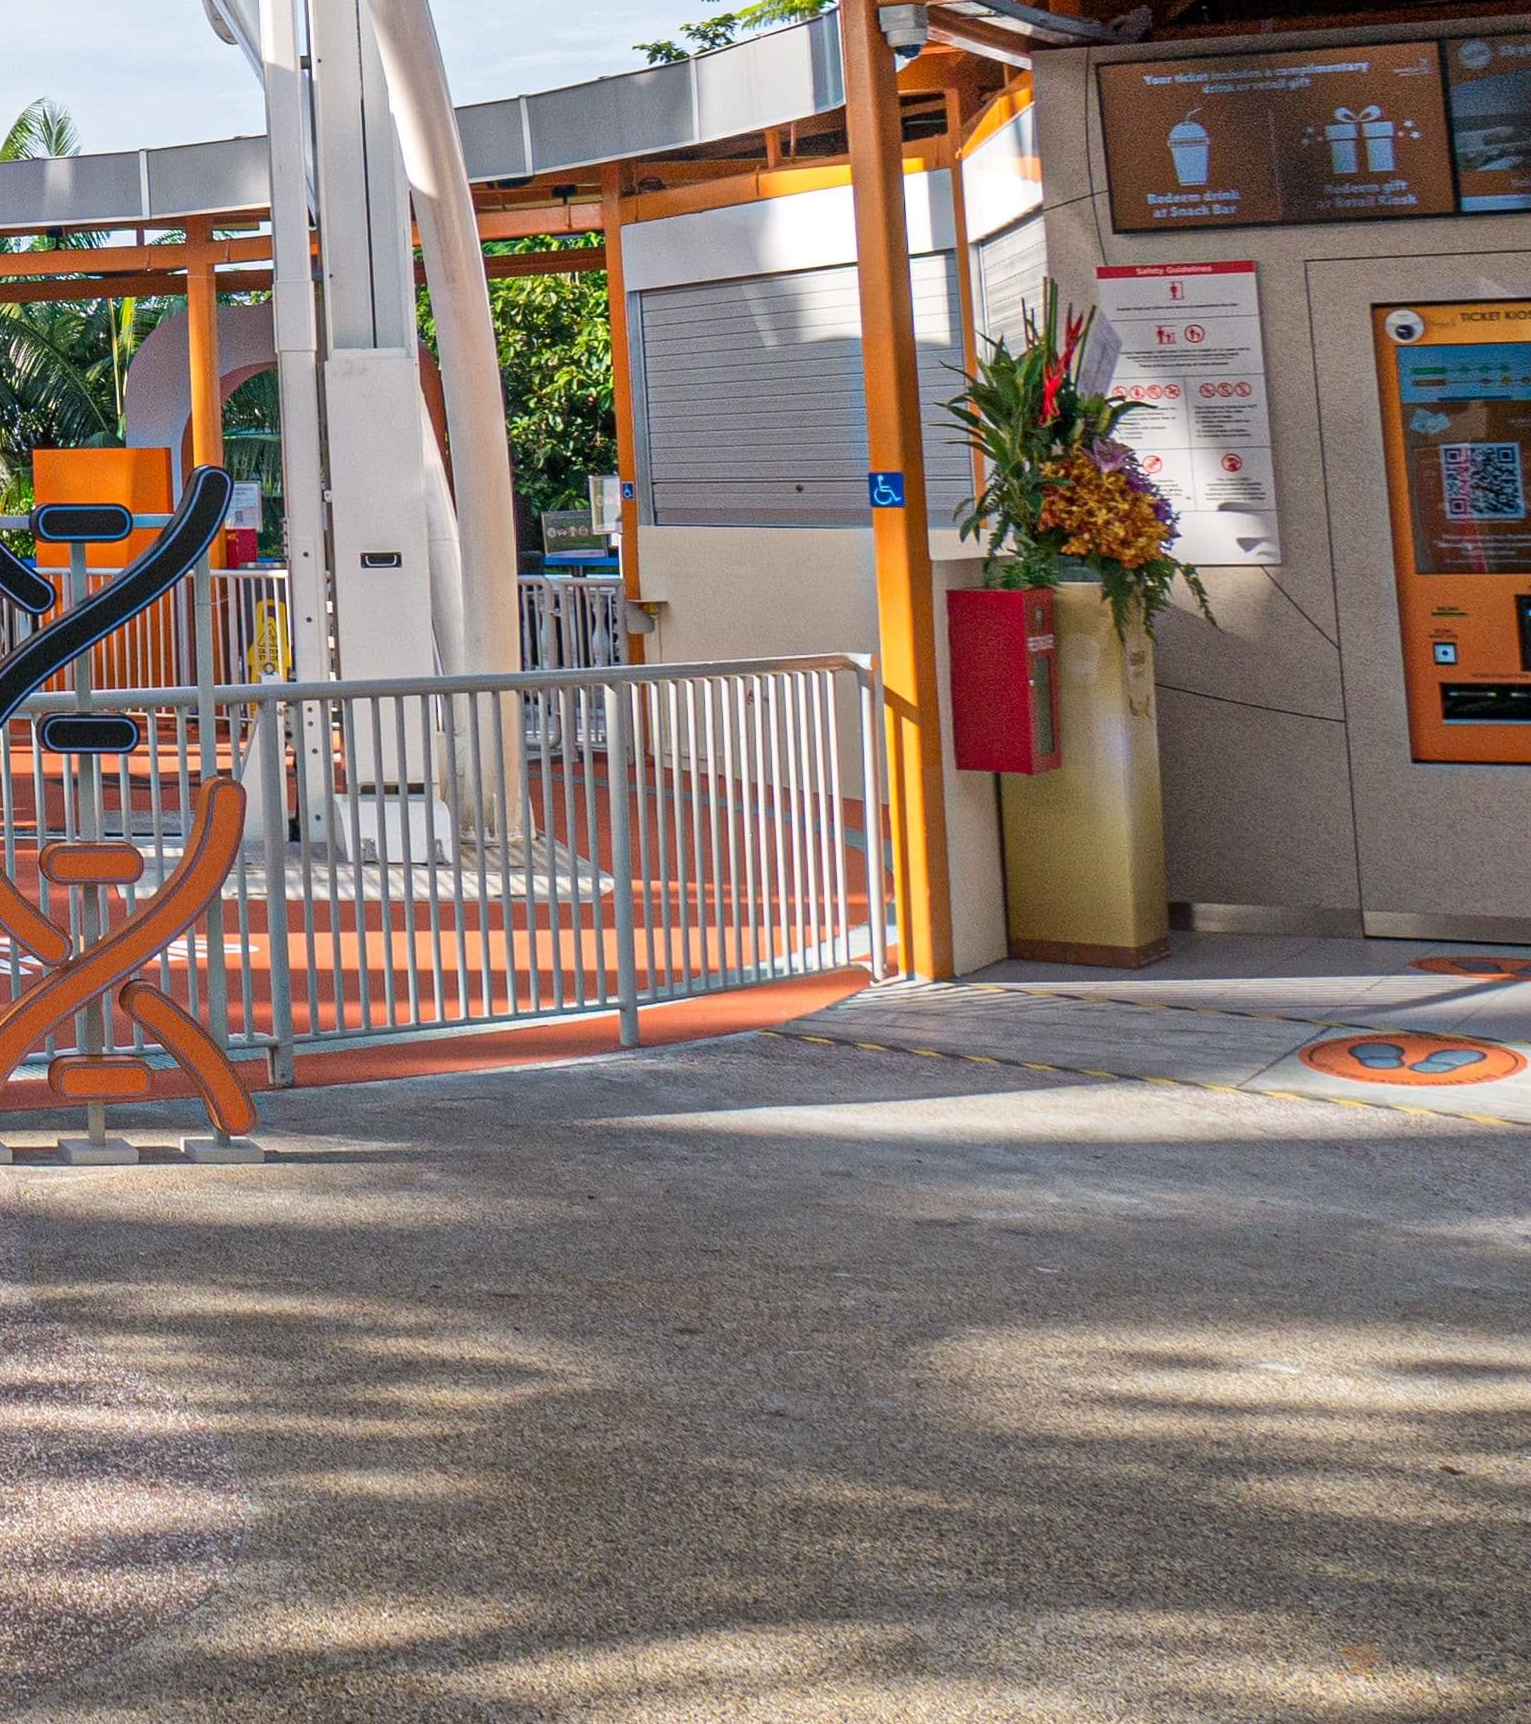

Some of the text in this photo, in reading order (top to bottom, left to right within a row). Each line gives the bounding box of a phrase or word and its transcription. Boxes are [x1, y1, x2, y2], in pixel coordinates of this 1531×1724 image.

[1147, 189, 1241, 204] Redeem drink
[1170, 205, 1211, 217] Snack
[1136, 265, 1212, 276] Safety Guidelines
[1459, 311, 1499, 321] TICKET
